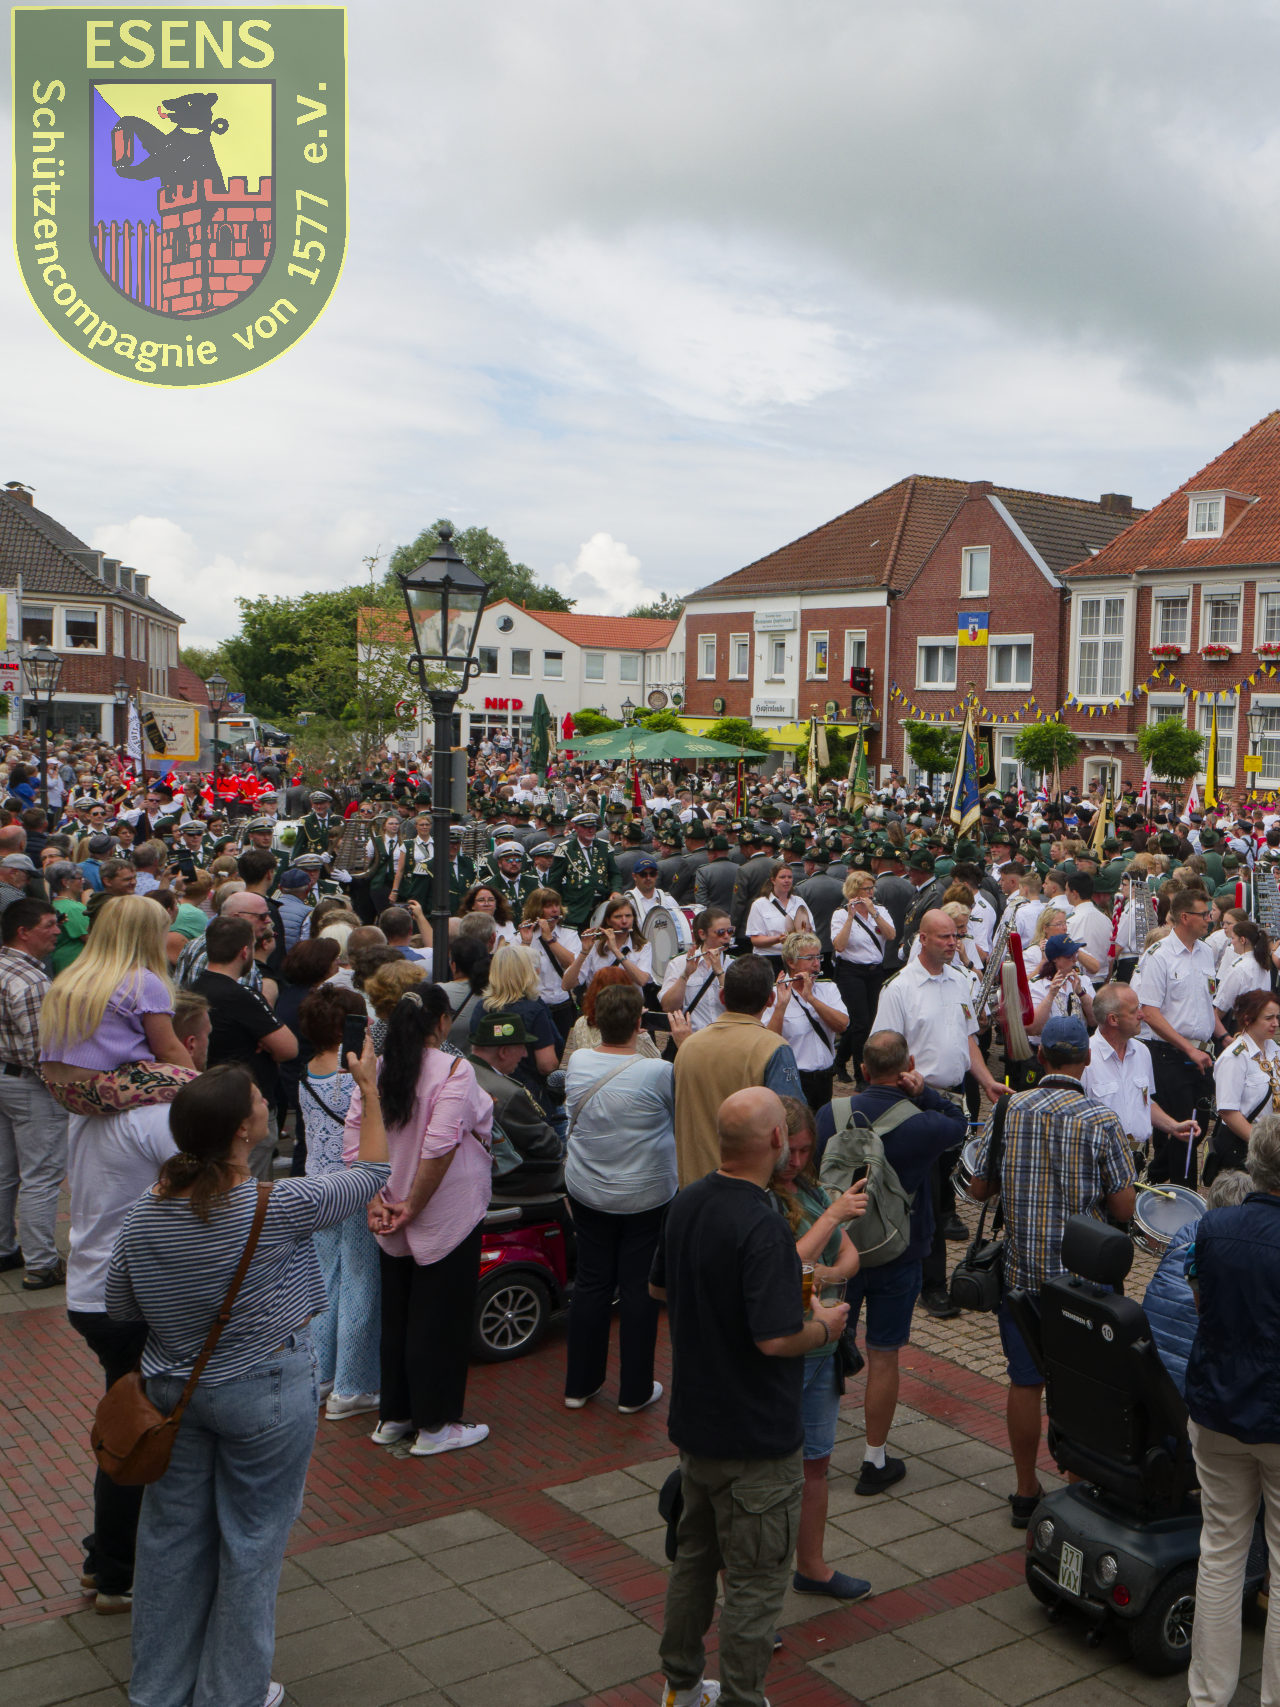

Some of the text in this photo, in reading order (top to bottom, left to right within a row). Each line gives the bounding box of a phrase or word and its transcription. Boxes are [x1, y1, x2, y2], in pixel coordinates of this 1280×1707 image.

[484, 697, 523, 710] NKD
[1102, 1326, 1112, 1339] 10
[1063, 1547, 1080, 1572] 371
[1061, 1566, 1079, 1591] VAX
